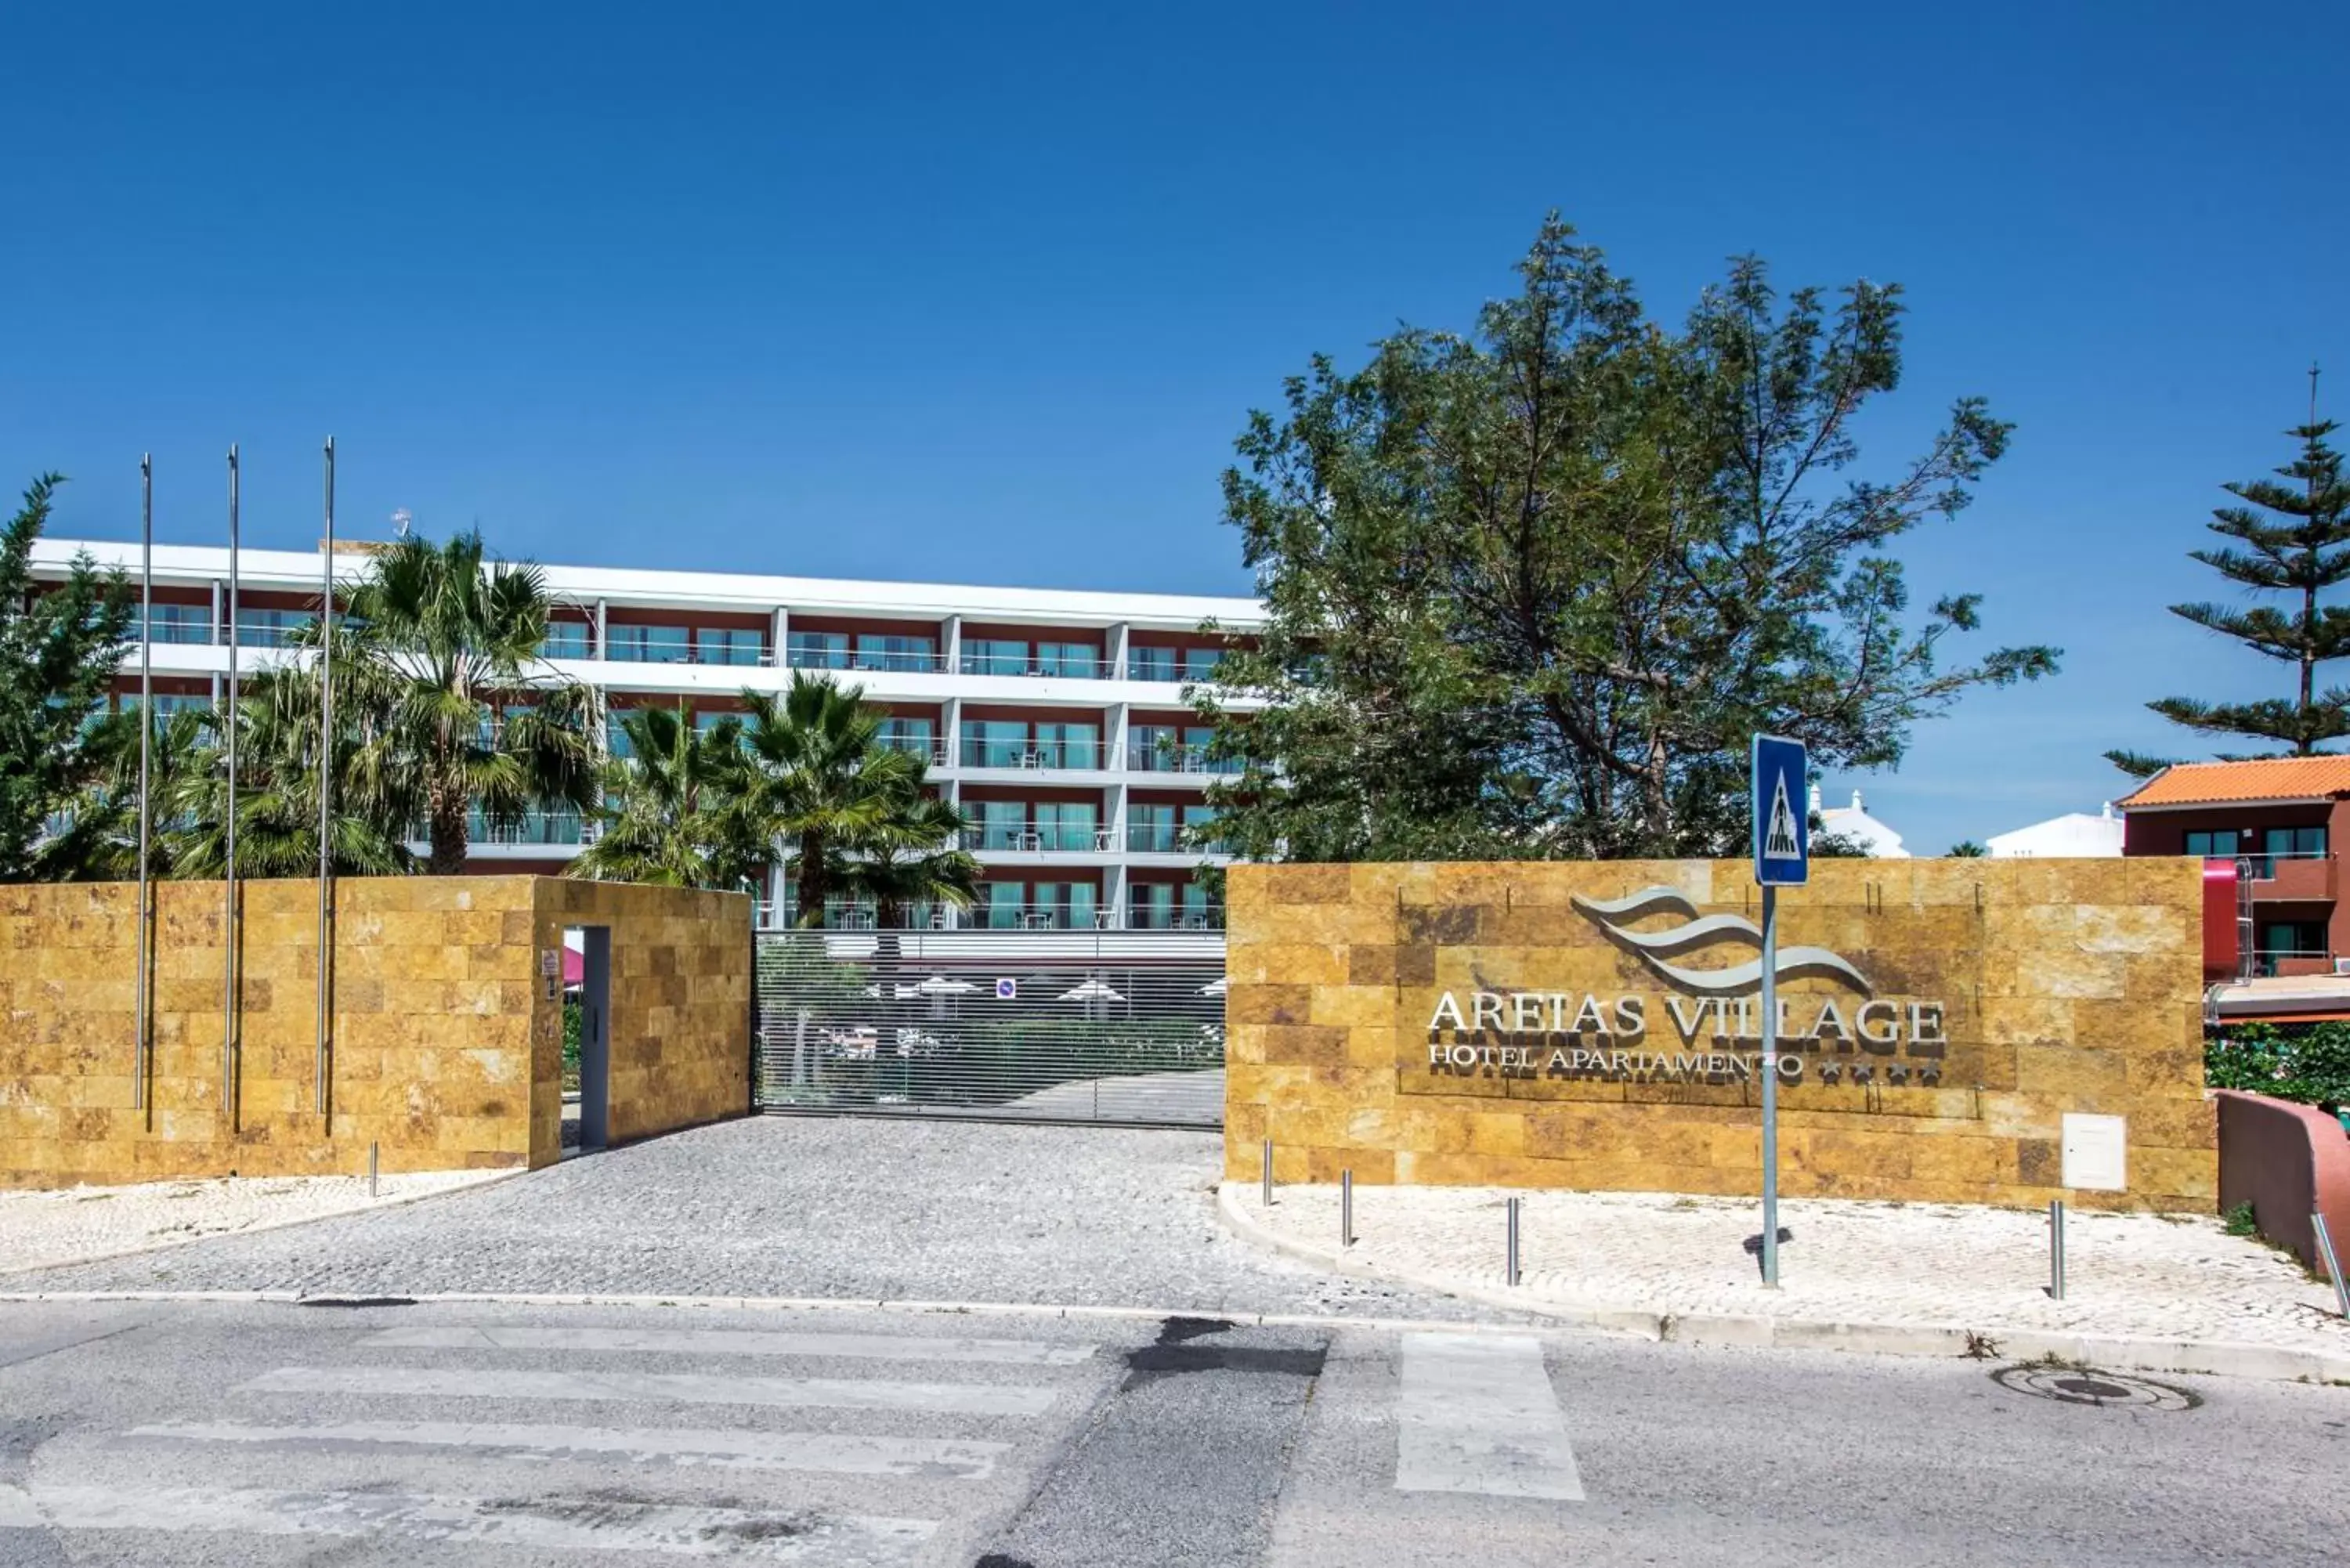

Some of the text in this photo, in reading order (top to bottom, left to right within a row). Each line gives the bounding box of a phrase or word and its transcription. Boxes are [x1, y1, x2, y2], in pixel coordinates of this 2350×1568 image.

[1427, 991, 1947, 1042] AREIAS VILLAGE
[1429, 1044, 1803, 1078] HOTEL APARTAMENO
